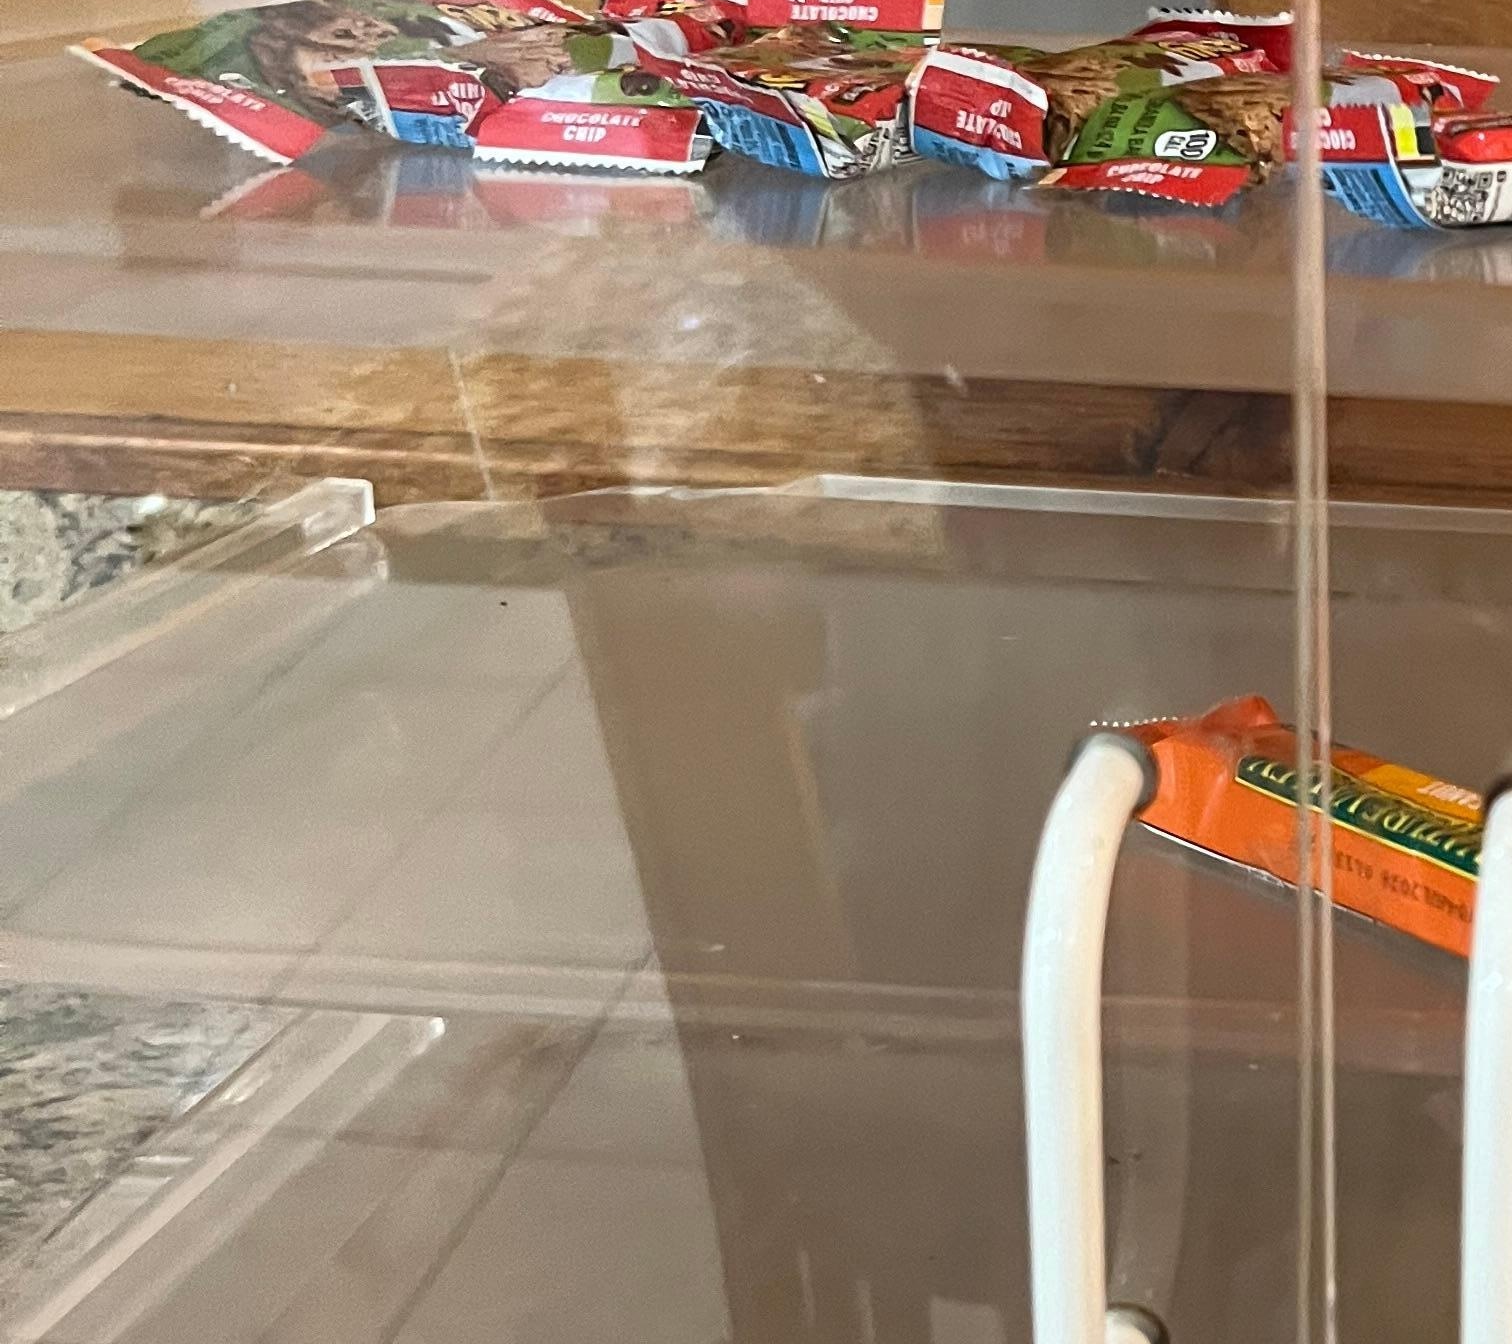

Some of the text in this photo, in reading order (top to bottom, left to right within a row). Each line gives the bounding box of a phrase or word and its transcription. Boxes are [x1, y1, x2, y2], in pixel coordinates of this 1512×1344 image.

[790, 4, 879, 22] CHOCOLATE
[541, 112, 642, 127] CHOCOLATE
[563, 125, 607, 143] CHIP
[1163, 136, 1186, 153] CAL
[1180, 132, 1210, 158] 100
[1107, 163, 1203, 179] CHOCOLATE
